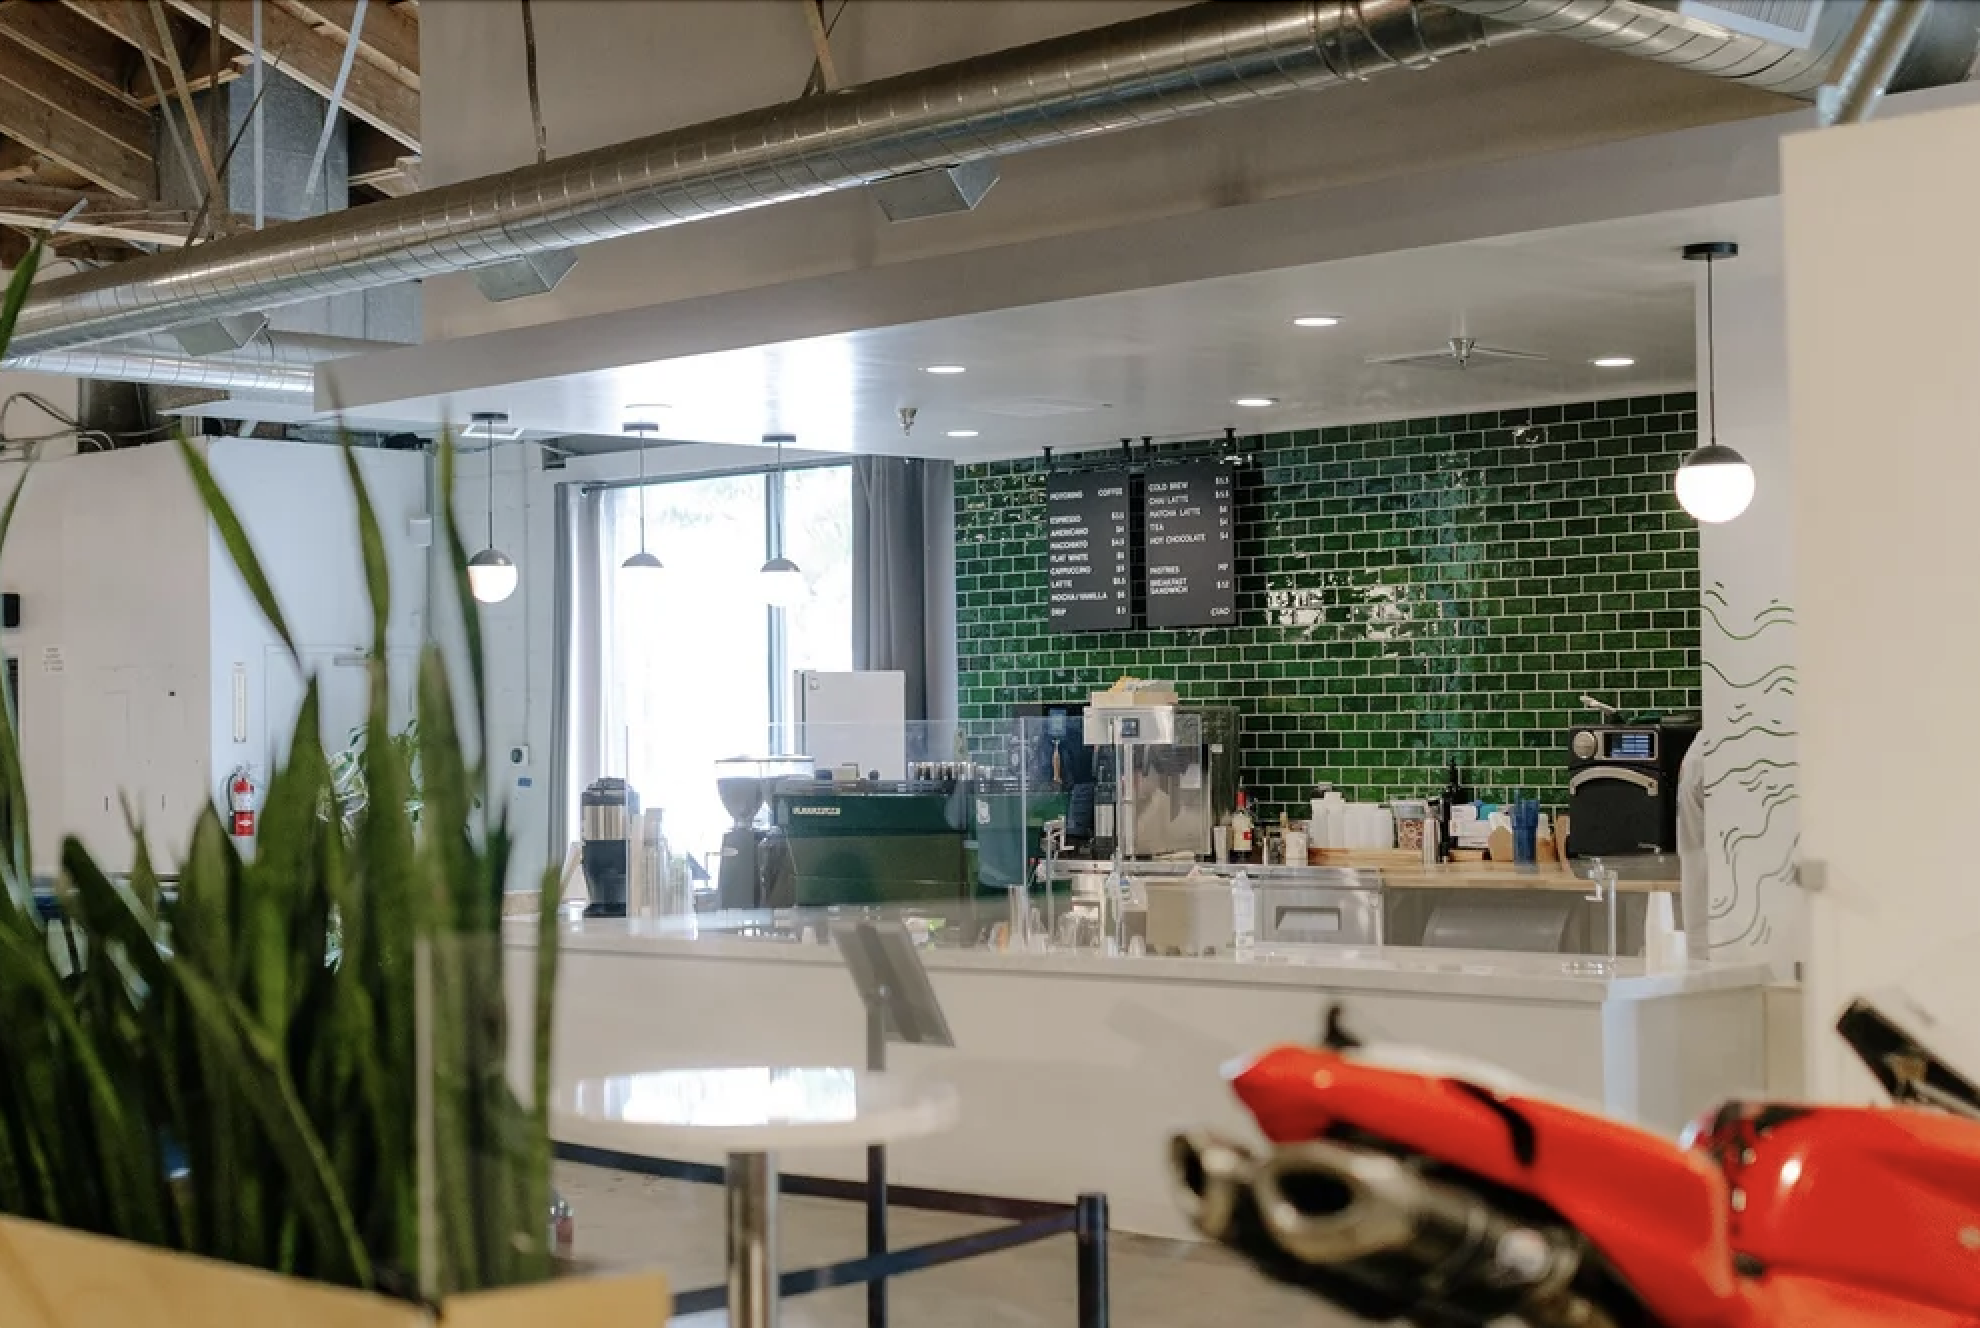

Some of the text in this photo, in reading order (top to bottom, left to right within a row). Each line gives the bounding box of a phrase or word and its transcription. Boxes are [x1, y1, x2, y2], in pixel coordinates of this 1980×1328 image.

[1148, 483, 1168, 492] COLD
[1169, 481, 1189, 490] BREW
[1097, 487, 1123, 496] COFFEE
[1148, 497, 1165, 505] CHAI
[1168, 494, 1189, 504] LATTE
[1149, 509, 1177, 518] MATCHA
[1179, 507, 1201, 516] LATTE
[1049, 514, 1082, 524] ESPRESSO
[1149, 523, 1165, 531] TEA
[1049, 527, 1089, 537] AMERICANO
[1149, 535, 1165, 544] HOT
[1165, 533, 1207, 544] CHOCOLATE
[1049, 554, 1067, 562] FLAT
[1067, 552, 1089, 561] WHITE
[1049, 566, 1092, 575] CAPPUCCINO
[1149, 565, 1181, 574] PASTRIES
[1050, 579, 1073, 588] LATTE
[1149, 577, 1187, 586] BREAKFAST
[1149, 586, 1189, 595] SANDWICH
[1051, 592, 1108, 602] MOCHA/VANILLA
[1050, 607, 1067, 616] DRIP
